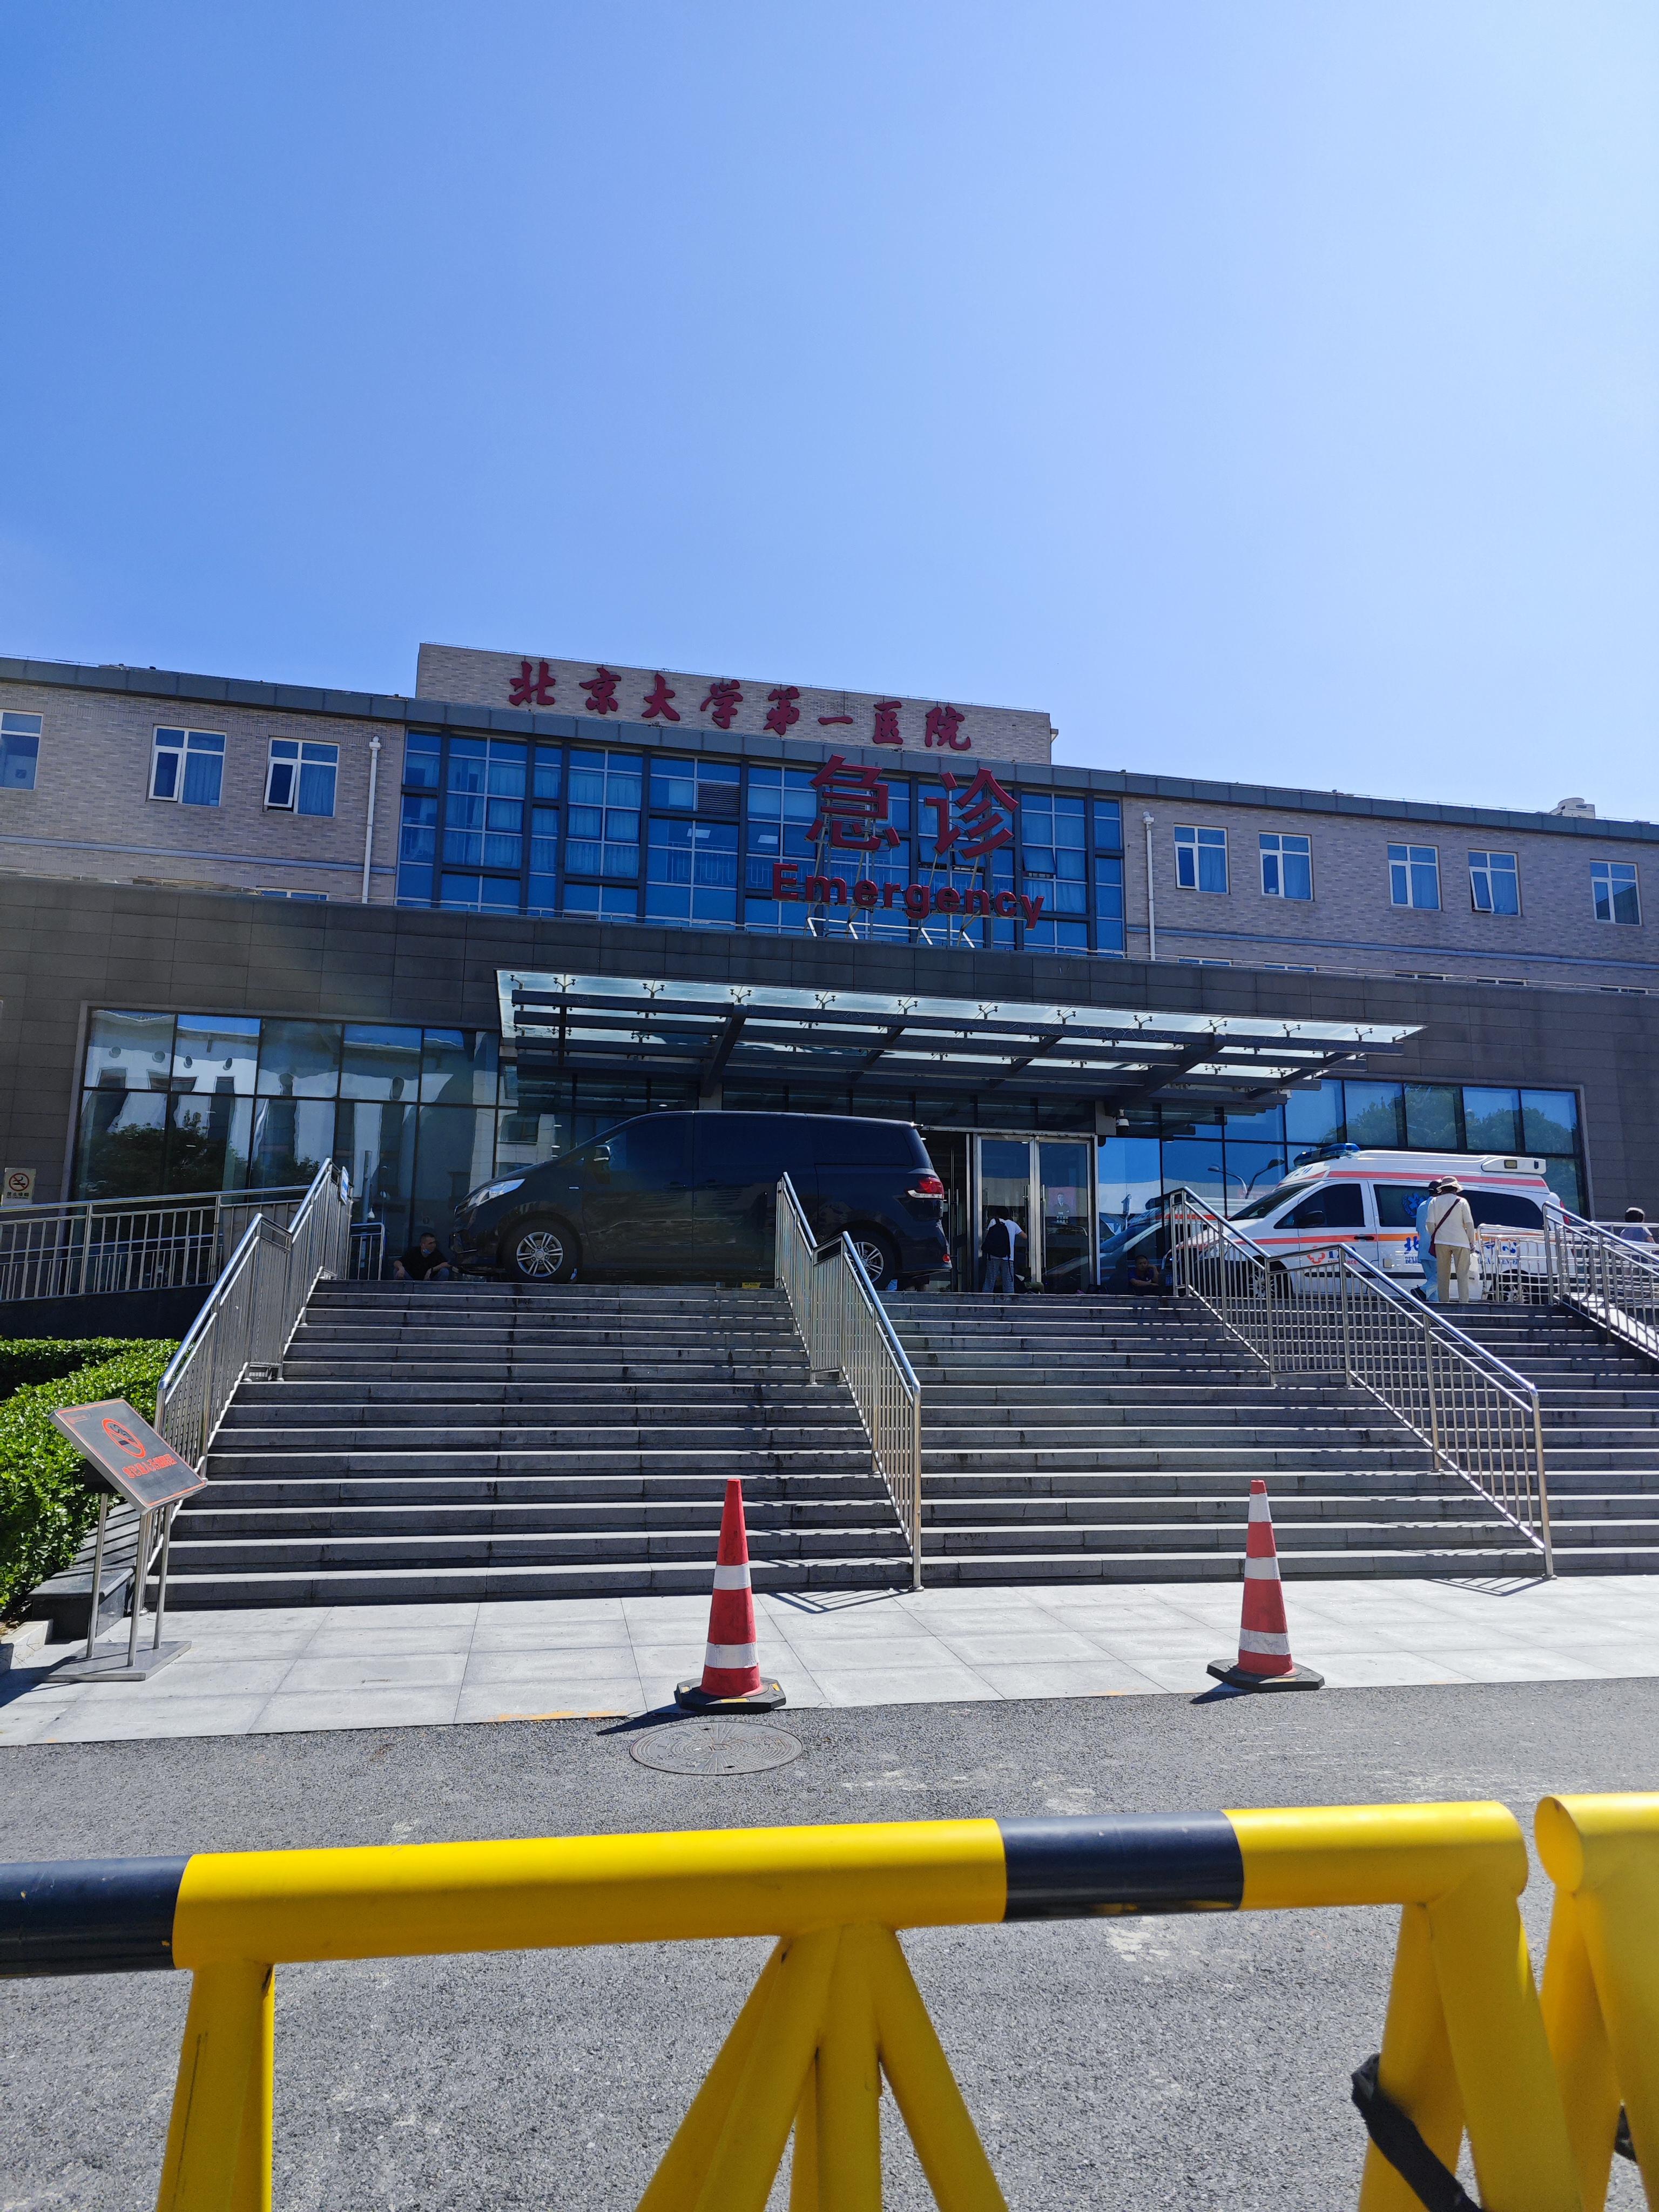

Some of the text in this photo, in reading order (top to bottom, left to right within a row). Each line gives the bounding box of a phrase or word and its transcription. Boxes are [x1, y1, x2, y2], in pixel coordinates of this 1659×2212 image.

[509, 662, 971, 751] 北京大学第一医院
[804, 754, 1019, 860] 急诊
[772, 862, 1044, 929] Emergency
